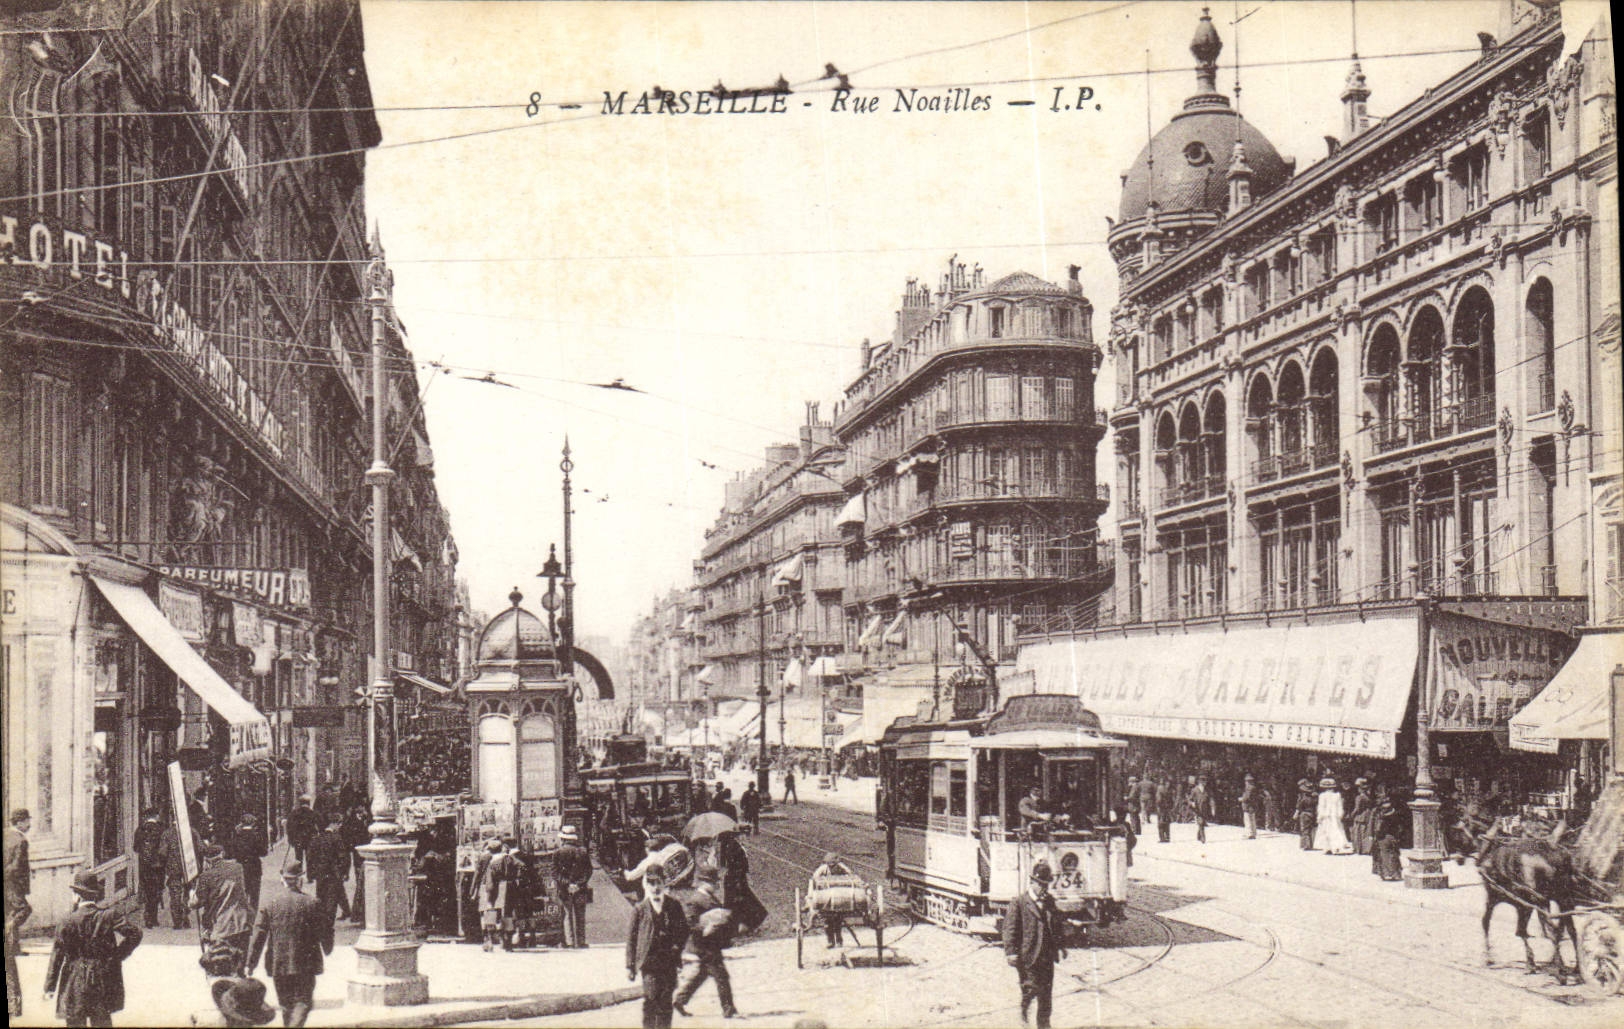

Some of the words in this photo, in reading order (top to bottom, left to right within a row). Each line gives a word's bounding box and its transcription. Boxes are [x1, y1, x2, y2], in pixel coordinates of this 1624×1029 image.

[1195, 720, 1275, 741] NOUVELLES
[1286, 725, 1370, 750] GALERIES
[1051, 870, 1084, 891] 734
